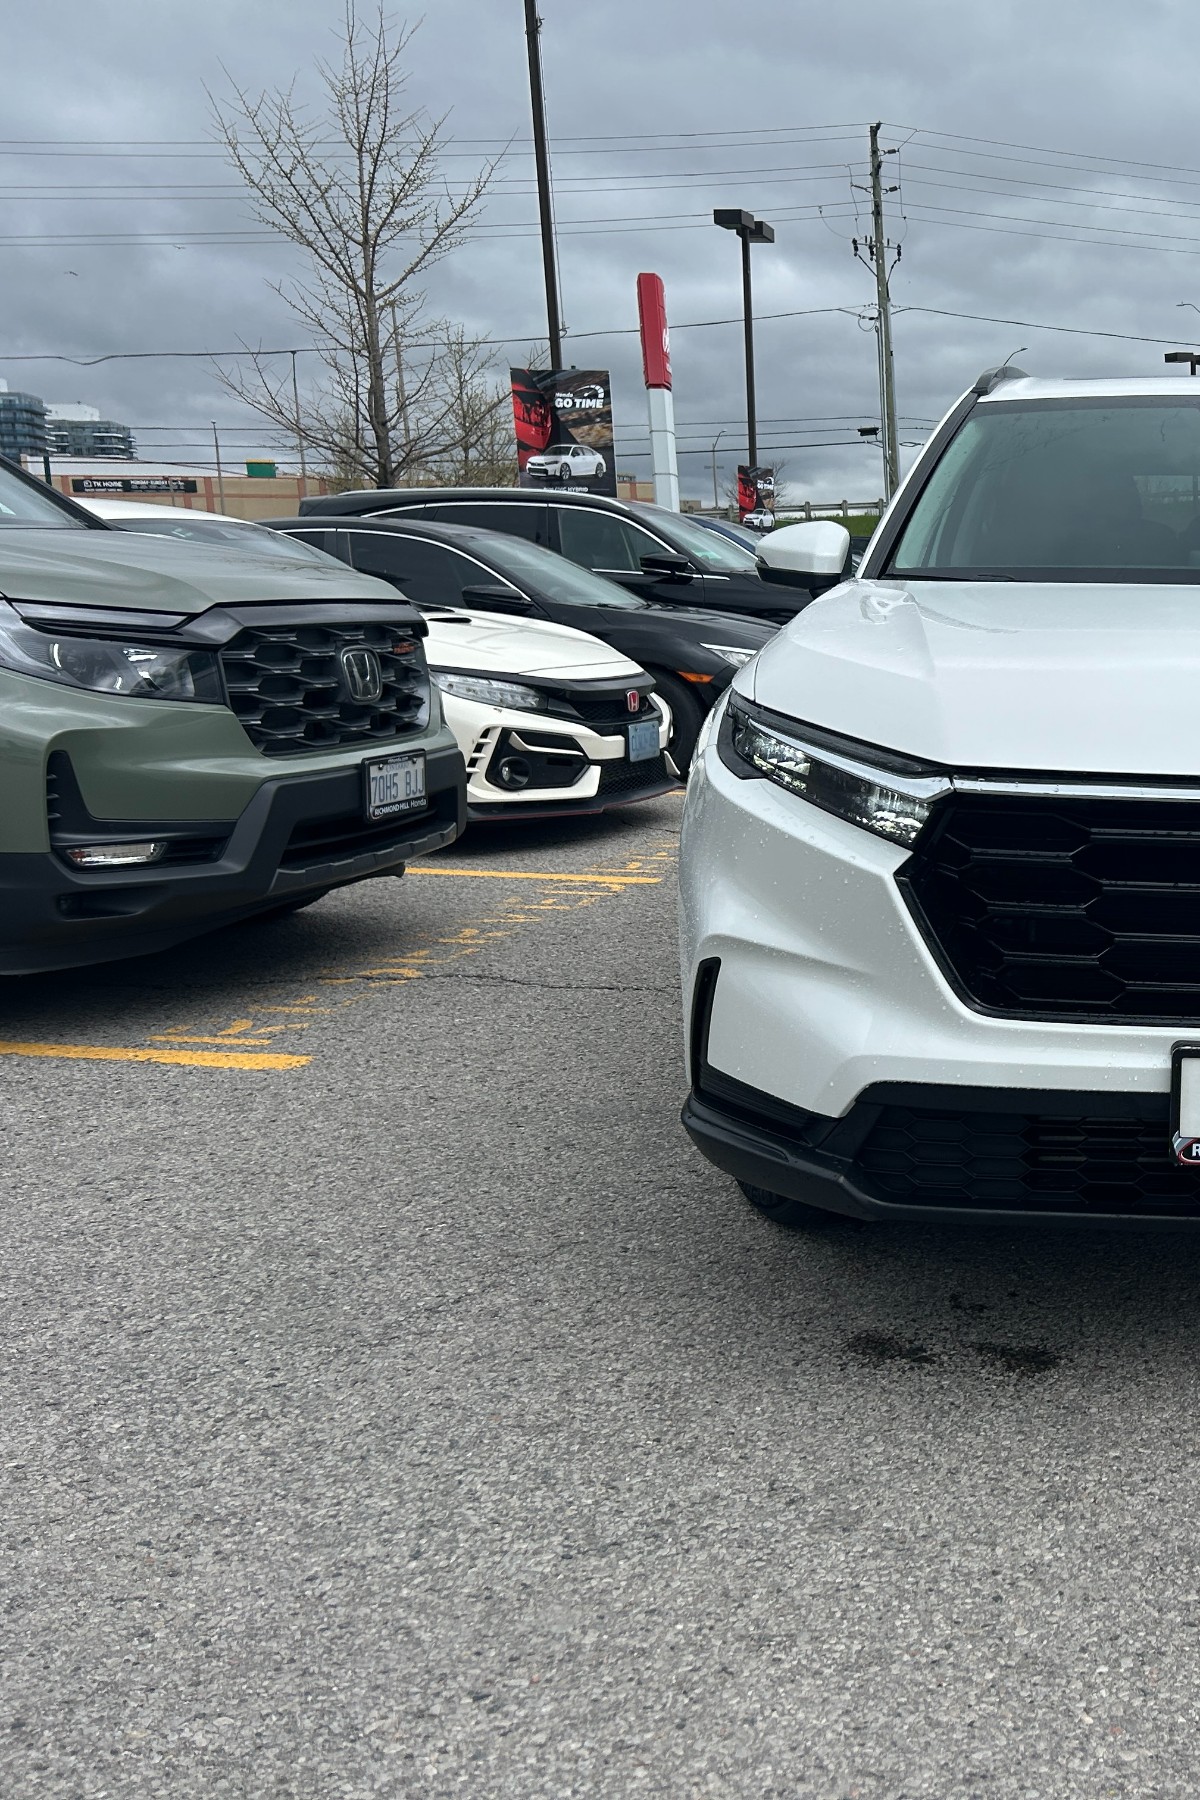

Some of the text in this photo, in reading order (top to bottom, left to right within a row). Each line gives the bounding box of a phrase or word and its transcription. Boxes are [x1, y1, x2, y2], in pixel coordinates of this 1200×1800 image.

[555, 398, 604, 409] GO TIME
[410, 798, 427, 808] Honda
